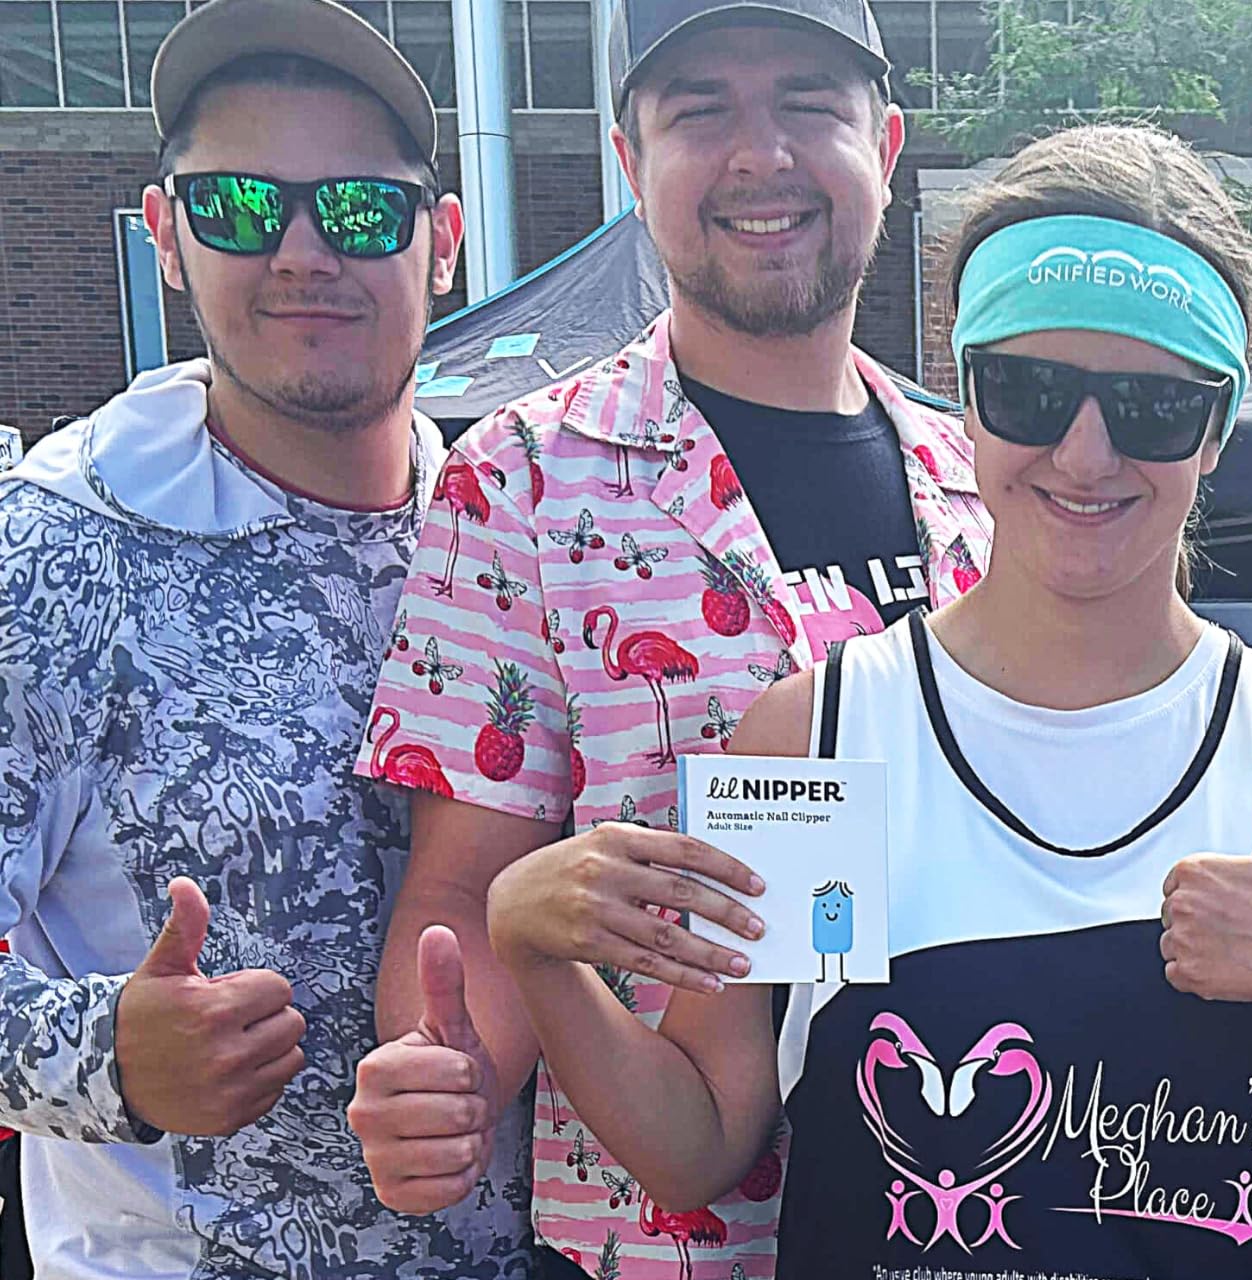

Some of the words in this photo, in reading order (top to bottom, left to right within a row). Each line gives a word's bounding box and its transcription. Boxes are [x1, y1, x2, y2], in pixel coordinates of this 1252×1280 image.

[1027, 264, 1126, 286] UNIFIED
[1129, 272, 1193, 315] WORK
[706, 777, 739, 799] lil
[742, 779, 845, 802] NIPPER
[706, 811, 764, 821] Automatic
[767, 812, 788, 821] Nail
[791, 812, 831, 824] Clipper
[707, 822, 731, 830] Adult
[734, 823, 753, 831] Size
[1081, 1144, 1216, 1224] Place
